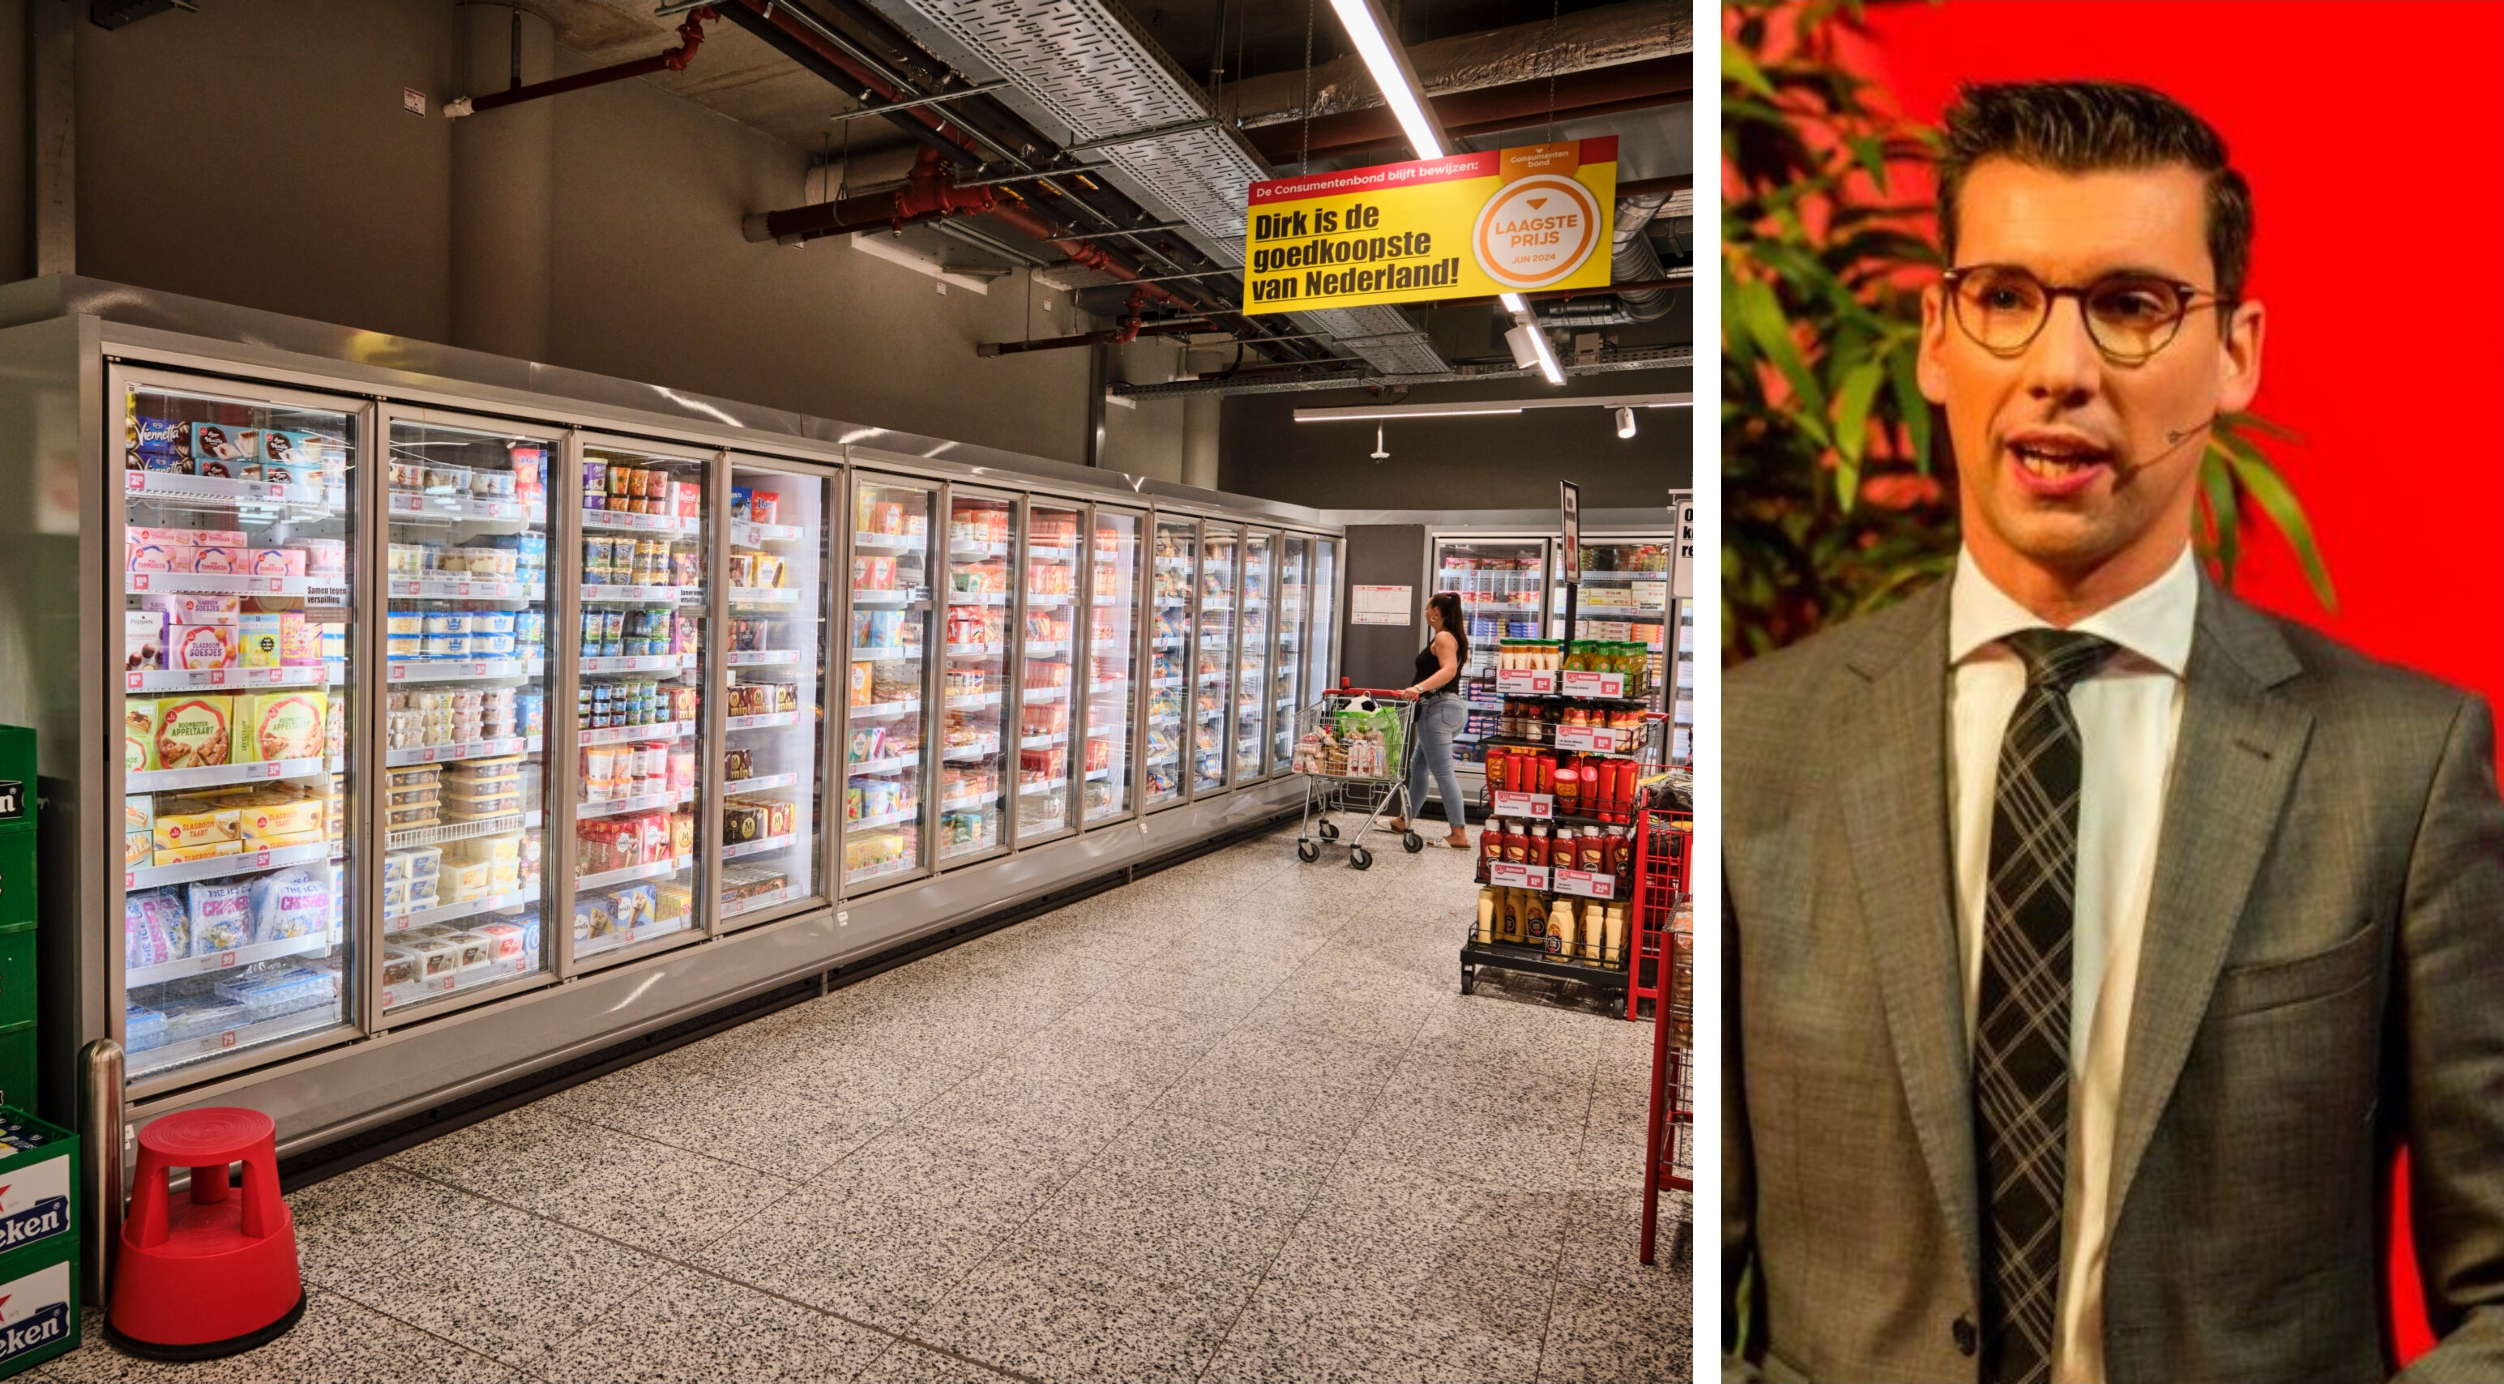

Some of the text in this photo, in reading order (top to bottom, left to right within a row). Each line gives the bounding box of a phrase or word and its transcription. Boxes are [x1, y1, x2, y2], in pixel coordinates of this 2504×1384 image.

[1510, 150, 1569, 163] Consumenten
[1528, 159, 1550, 168] bond
[1256, 160, 1479, 198] De Consumentenbond blijft bewijzen:
[1255, 203, 1379, 240] Dirk is de
[1495, 214, 1577, 236] LAAGSTE
[1510, 230, 1560, 248] PRIJS
[1254, 231, 1431, 274] goedkoopste
[1512, 252, 1556, 264] JUN 2024
[1252, 257, 1460, 299] van Nederland!
[134, 421, 179, 447] Viennetta
[1683, 526, 1693, 539] k
[308, 586, 347, 595] Samen tegen
[308, 596, 340, 604] verspilling
[190, 649, 222, 657] SOESJES
[172, 725, 214, 737] APPELTAART
[269, 811, 298, 822] SLAGROOM
[182, 820, 215, 832] SLAGROOM
[275, 818, 292, 828] TAART
[189, 829, 208, 838] TAART
[223, 954, 234, 965] 99
[223, 1034, 234, 1046] 79
